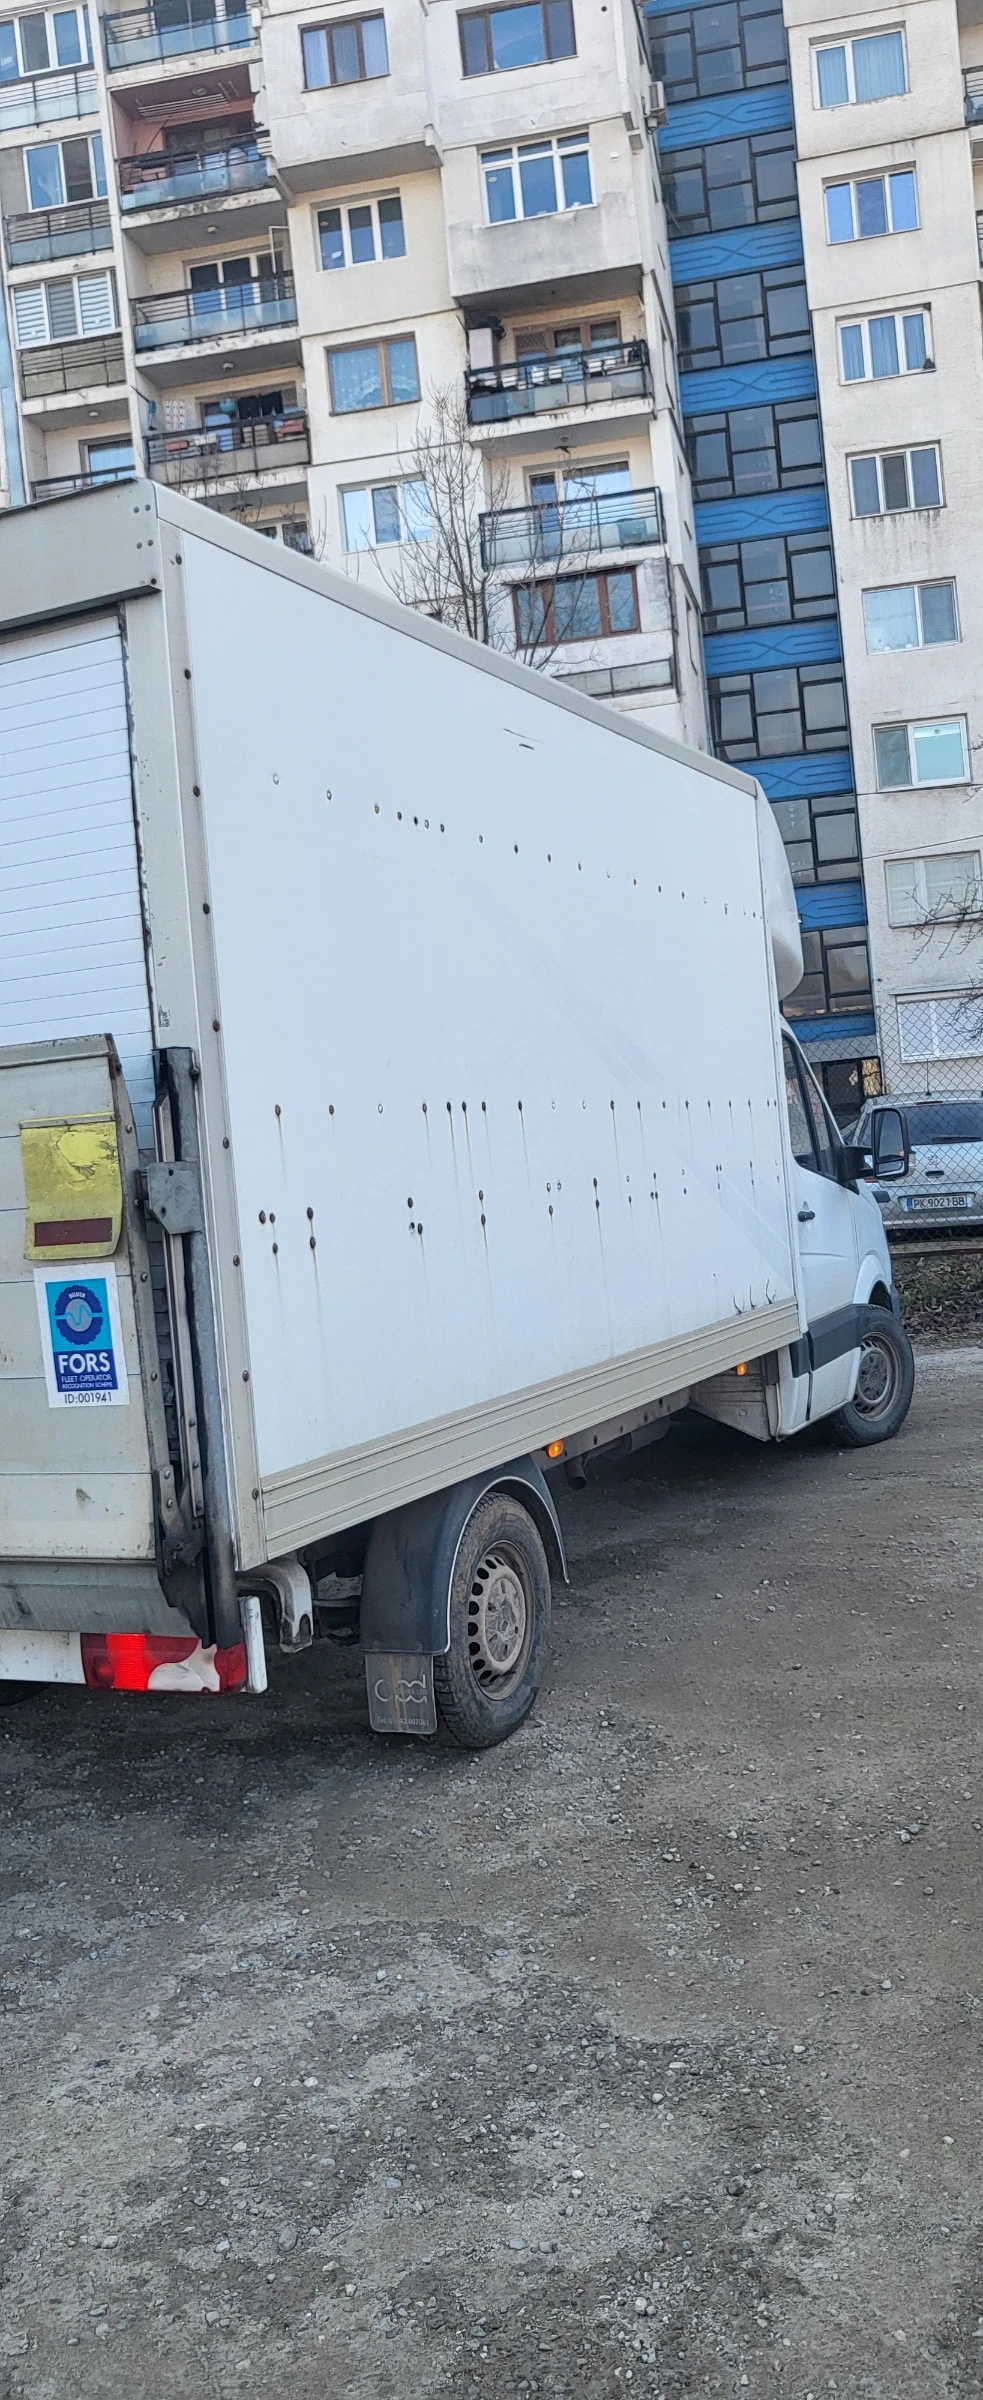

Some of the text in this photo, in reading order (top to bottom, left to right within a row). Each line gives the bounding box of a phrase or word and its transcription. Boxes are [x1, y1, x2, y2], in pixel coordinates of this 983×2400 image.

[58, 1352, 111, 1374] FORS
[61, 1373, 113, 1384] FLEET OPERATOR
[64, 1392, 112, 1404] ID:001941
